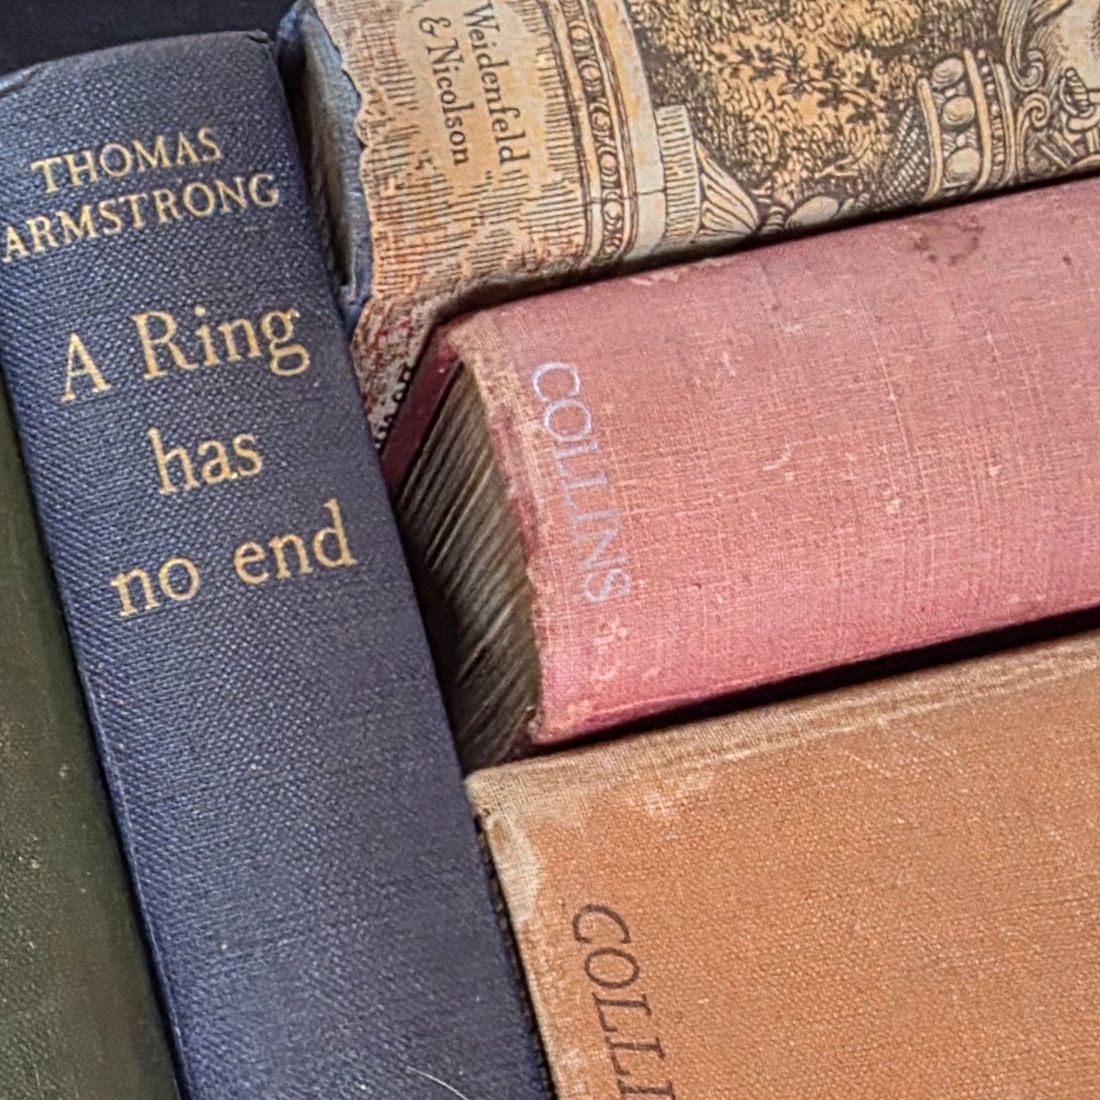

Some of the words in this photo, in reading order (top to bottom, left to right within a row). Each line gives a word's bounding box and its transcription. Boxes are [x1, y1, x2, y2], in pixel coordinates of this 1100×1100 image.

[426, 38, 475, 165] Nicolson
[463, 2, 530, 165] Weidenfeld
[31, 127, 222, 194] THOMAS
[0, 173, 279, 264] ARMSTRONG
[59, 331, 112, 403] A
[131, 305, 310, 380] Ring
[149, 428, 263, 495] has
[530, 360, 632, 604] COLLINS
[109, 553, 199, 617] no
[234, 498, 358, 585] end
